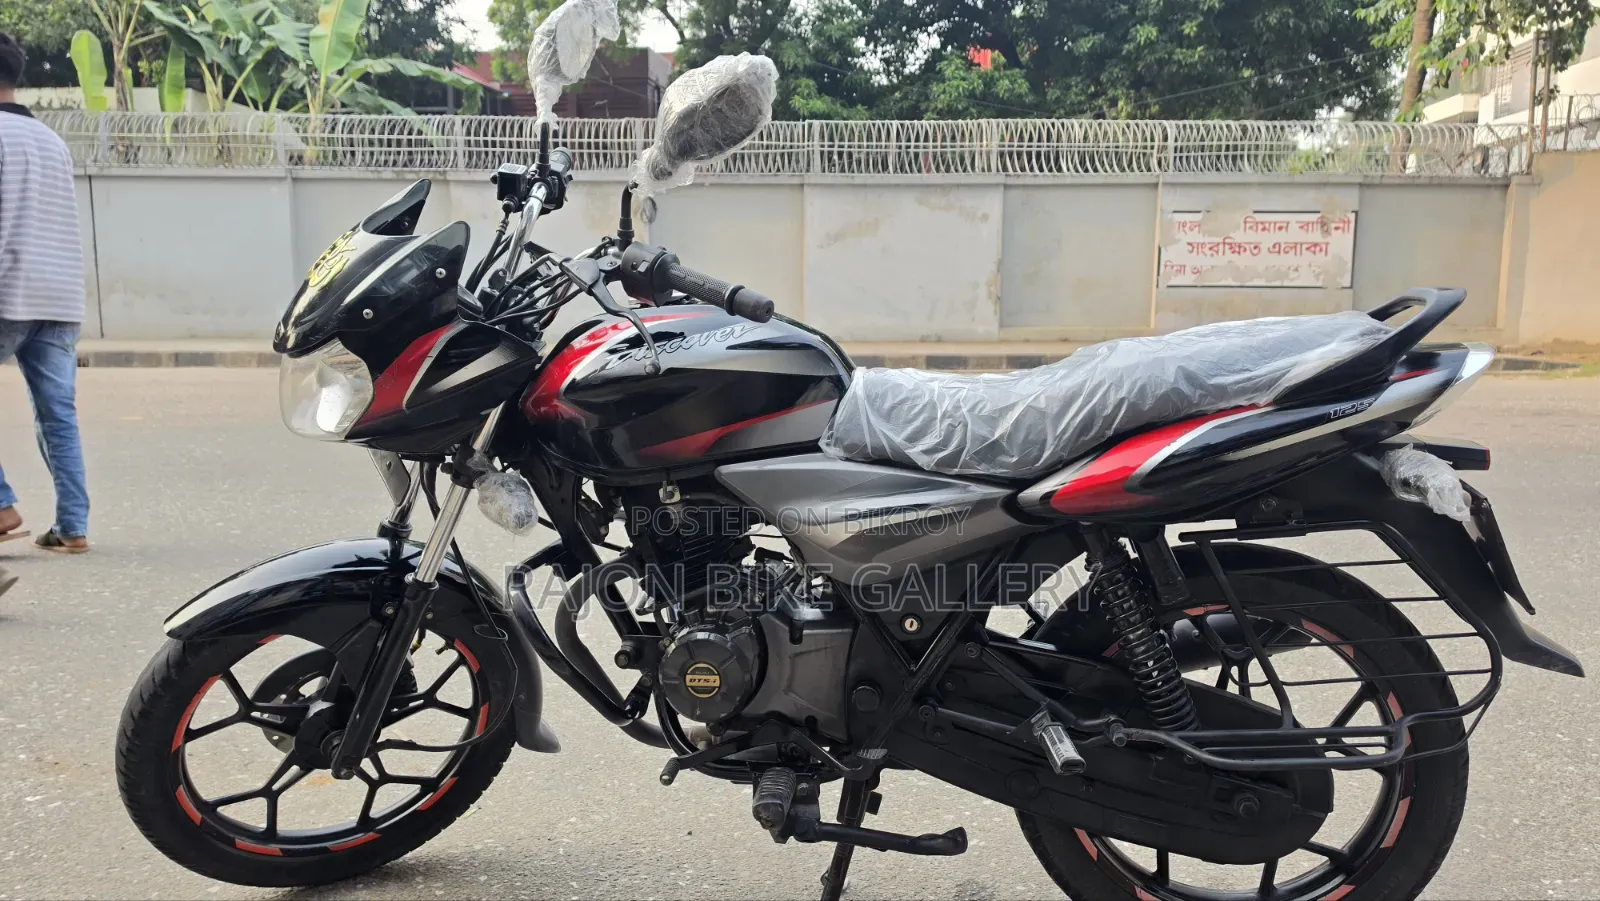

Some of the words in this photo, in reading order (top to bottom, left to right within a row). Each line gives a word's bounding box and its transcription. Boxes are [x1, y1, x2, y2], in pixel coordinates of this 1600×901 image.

[1242, 215, 1290, 235] বিমান
[1186, 236, 1262, 257] সংরক্ষিত
[1267, 241, 1330, 257] এলাকা
[1330, 398, 1376, 418] 125
